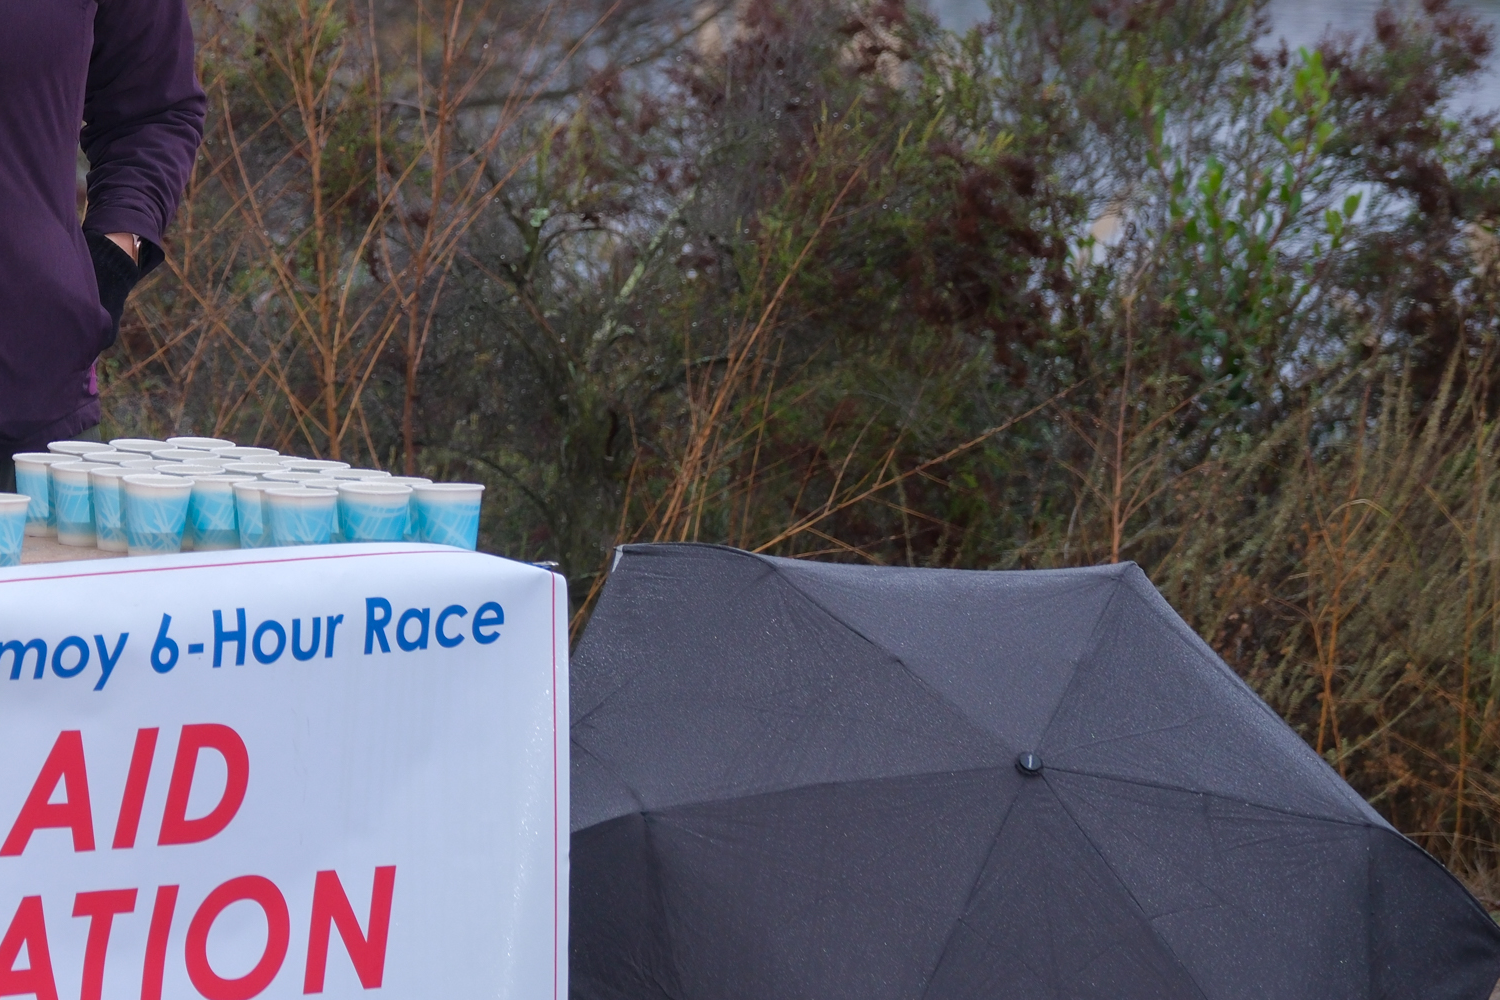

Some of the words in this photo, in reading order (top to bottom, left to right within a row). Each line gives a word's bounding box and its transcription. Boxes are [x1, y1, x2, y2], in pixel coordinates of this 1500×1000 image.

[151, 608, 344, 673] 6-Hour
[365, 597, 504, 654] Race
[0, 724, 248, 856] AID
